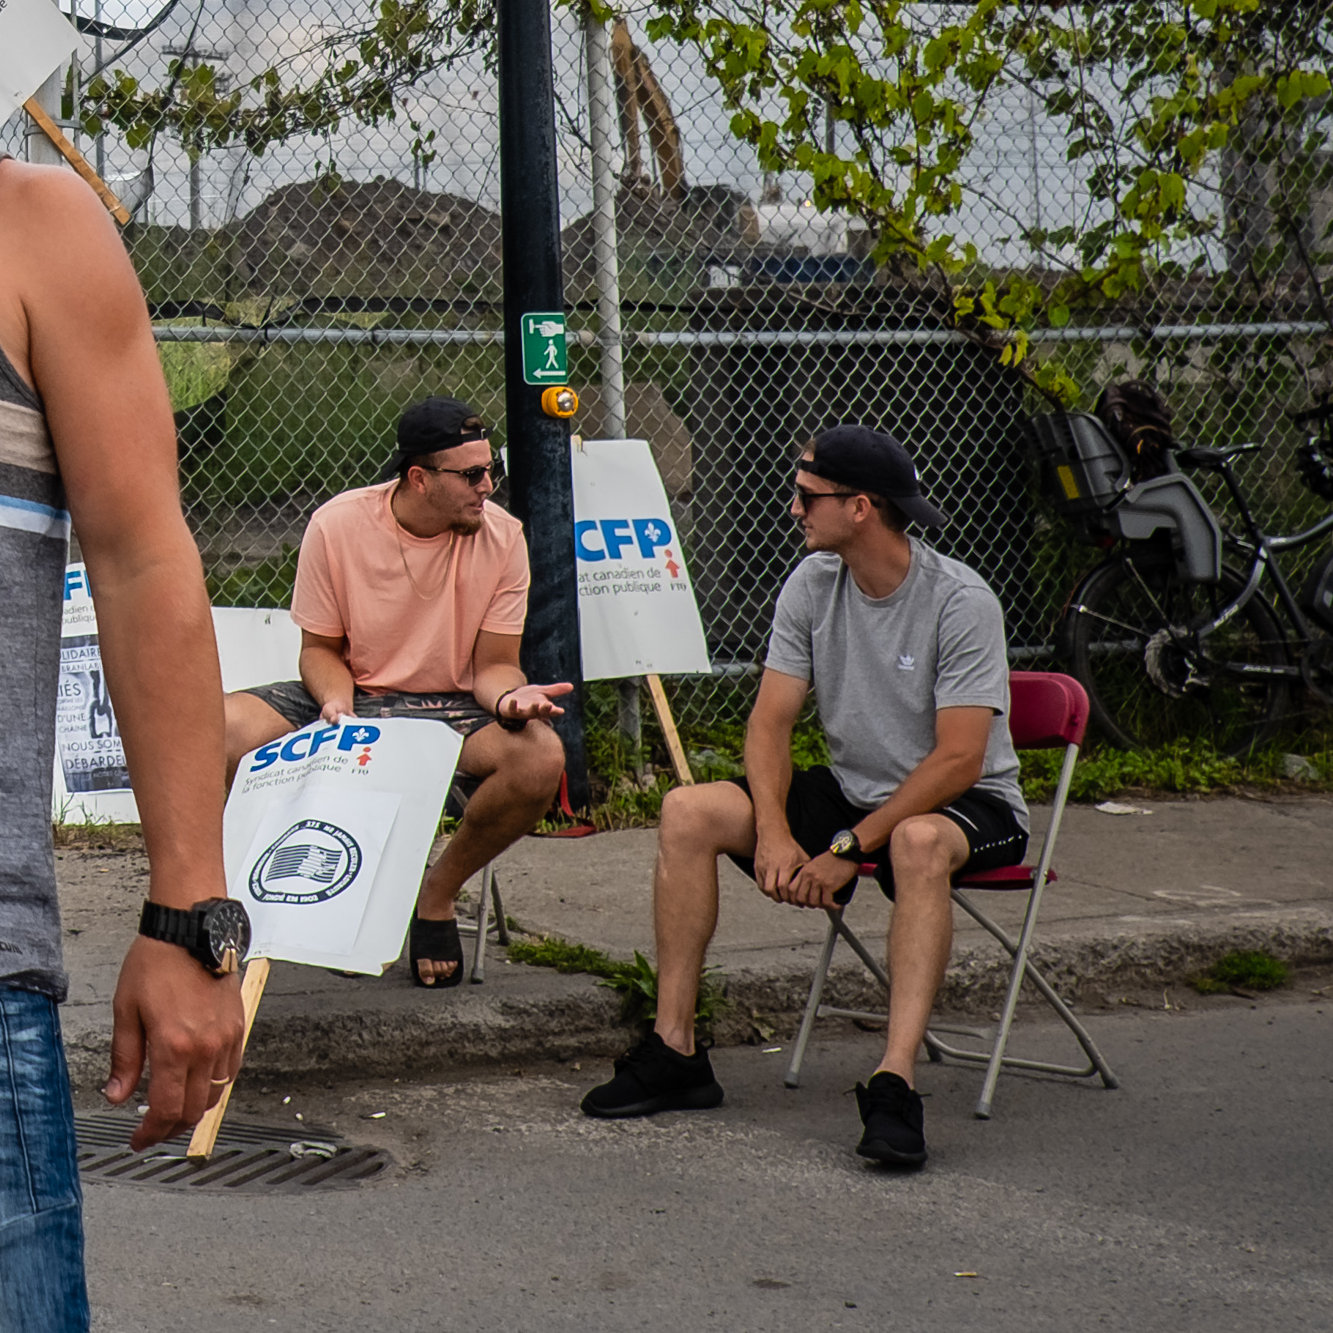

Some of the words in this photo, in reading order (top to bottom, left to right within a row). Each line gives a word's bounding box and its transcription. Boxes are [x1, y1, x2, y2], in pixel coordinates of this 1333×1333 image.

[575, 518, 672, 562] CFP
[593, 567, 645, 582] canadien
[647, 566, 661, 578] de
[579, 584, 609, 596] ction
[613, 581, 661, 595] publique
[64, 605, 88, 615] adien
[61, 647, 100, 660] LIDAIR
[58, 712, 86, 723] D'UNE
[62, 741, 95, 752] NOUS
[97, 739, 121, 750] SOM
[250, 724, 381, 773] SCFP
[65, 755, 126, 770] DÉBARDE
[245, 768, 285, 786] Syndicat
[287, 755, 330, 775] canadien
[333, 755, 348, 765] de
[252, 775, 295, 791] fonction
